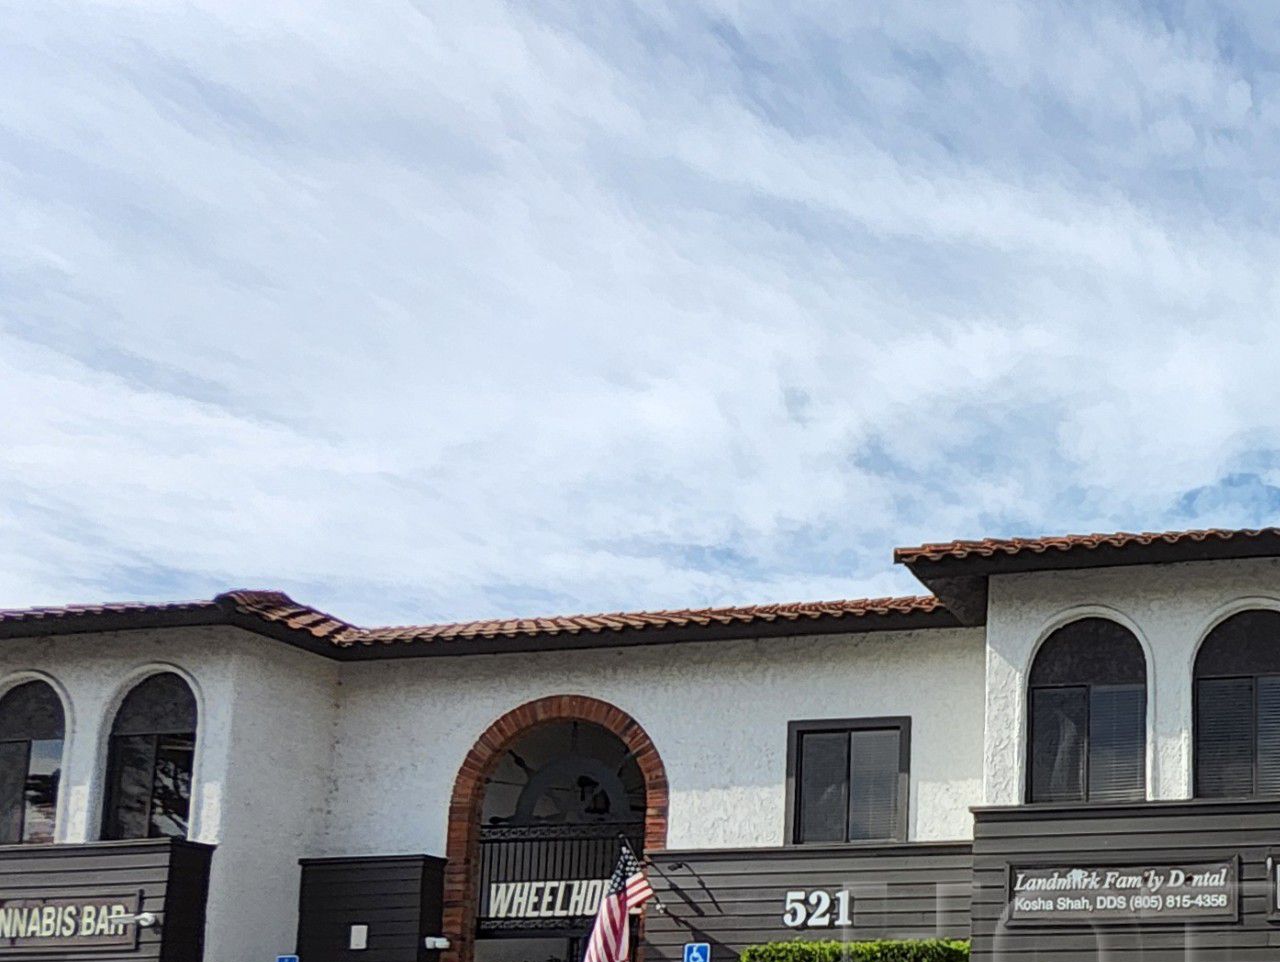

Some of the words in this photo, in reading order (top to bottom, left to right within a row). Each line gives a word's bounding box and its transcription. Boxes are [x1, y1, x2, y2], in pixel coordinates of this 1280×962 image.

[1014, 869, 1101, 891] Landmrk
[1167, 868, 1228, 888] Dntal
[783, 889, 853, 927] 521
[1014, 896, 1054, 911] Kosha
[1056, 896, 1094, 912] Shah,
[1096, 895, 1127, 909] DDS
[1129, 894, 1163, 912] (805)
